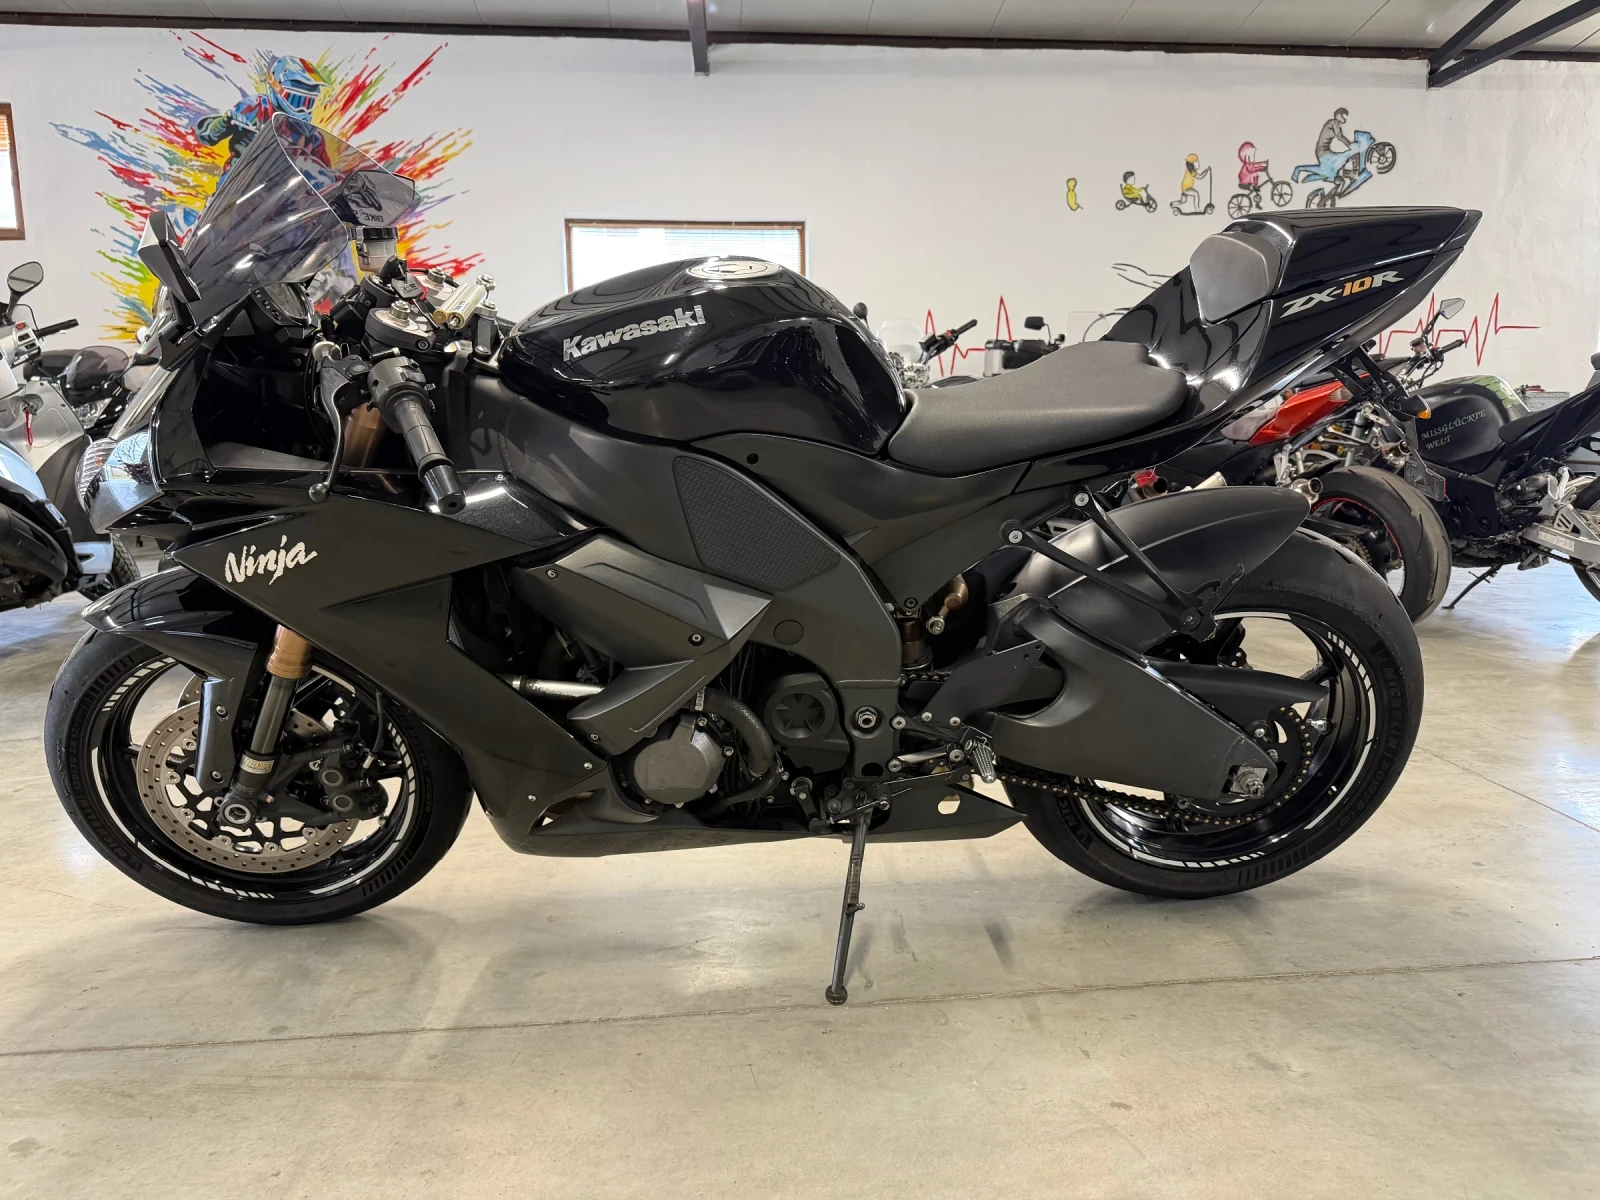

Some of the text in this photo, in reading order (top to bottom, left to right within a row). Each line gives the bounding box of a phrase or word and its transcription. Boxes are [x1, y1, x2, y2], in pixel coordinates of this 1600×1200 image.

[1279, 271, 1405, 319] ZX-10R
[563, 305, 706, 362] Kawasaki
[1426, 434, 1452, 451] WELT
[224, 534, 318, 586] Ninja
